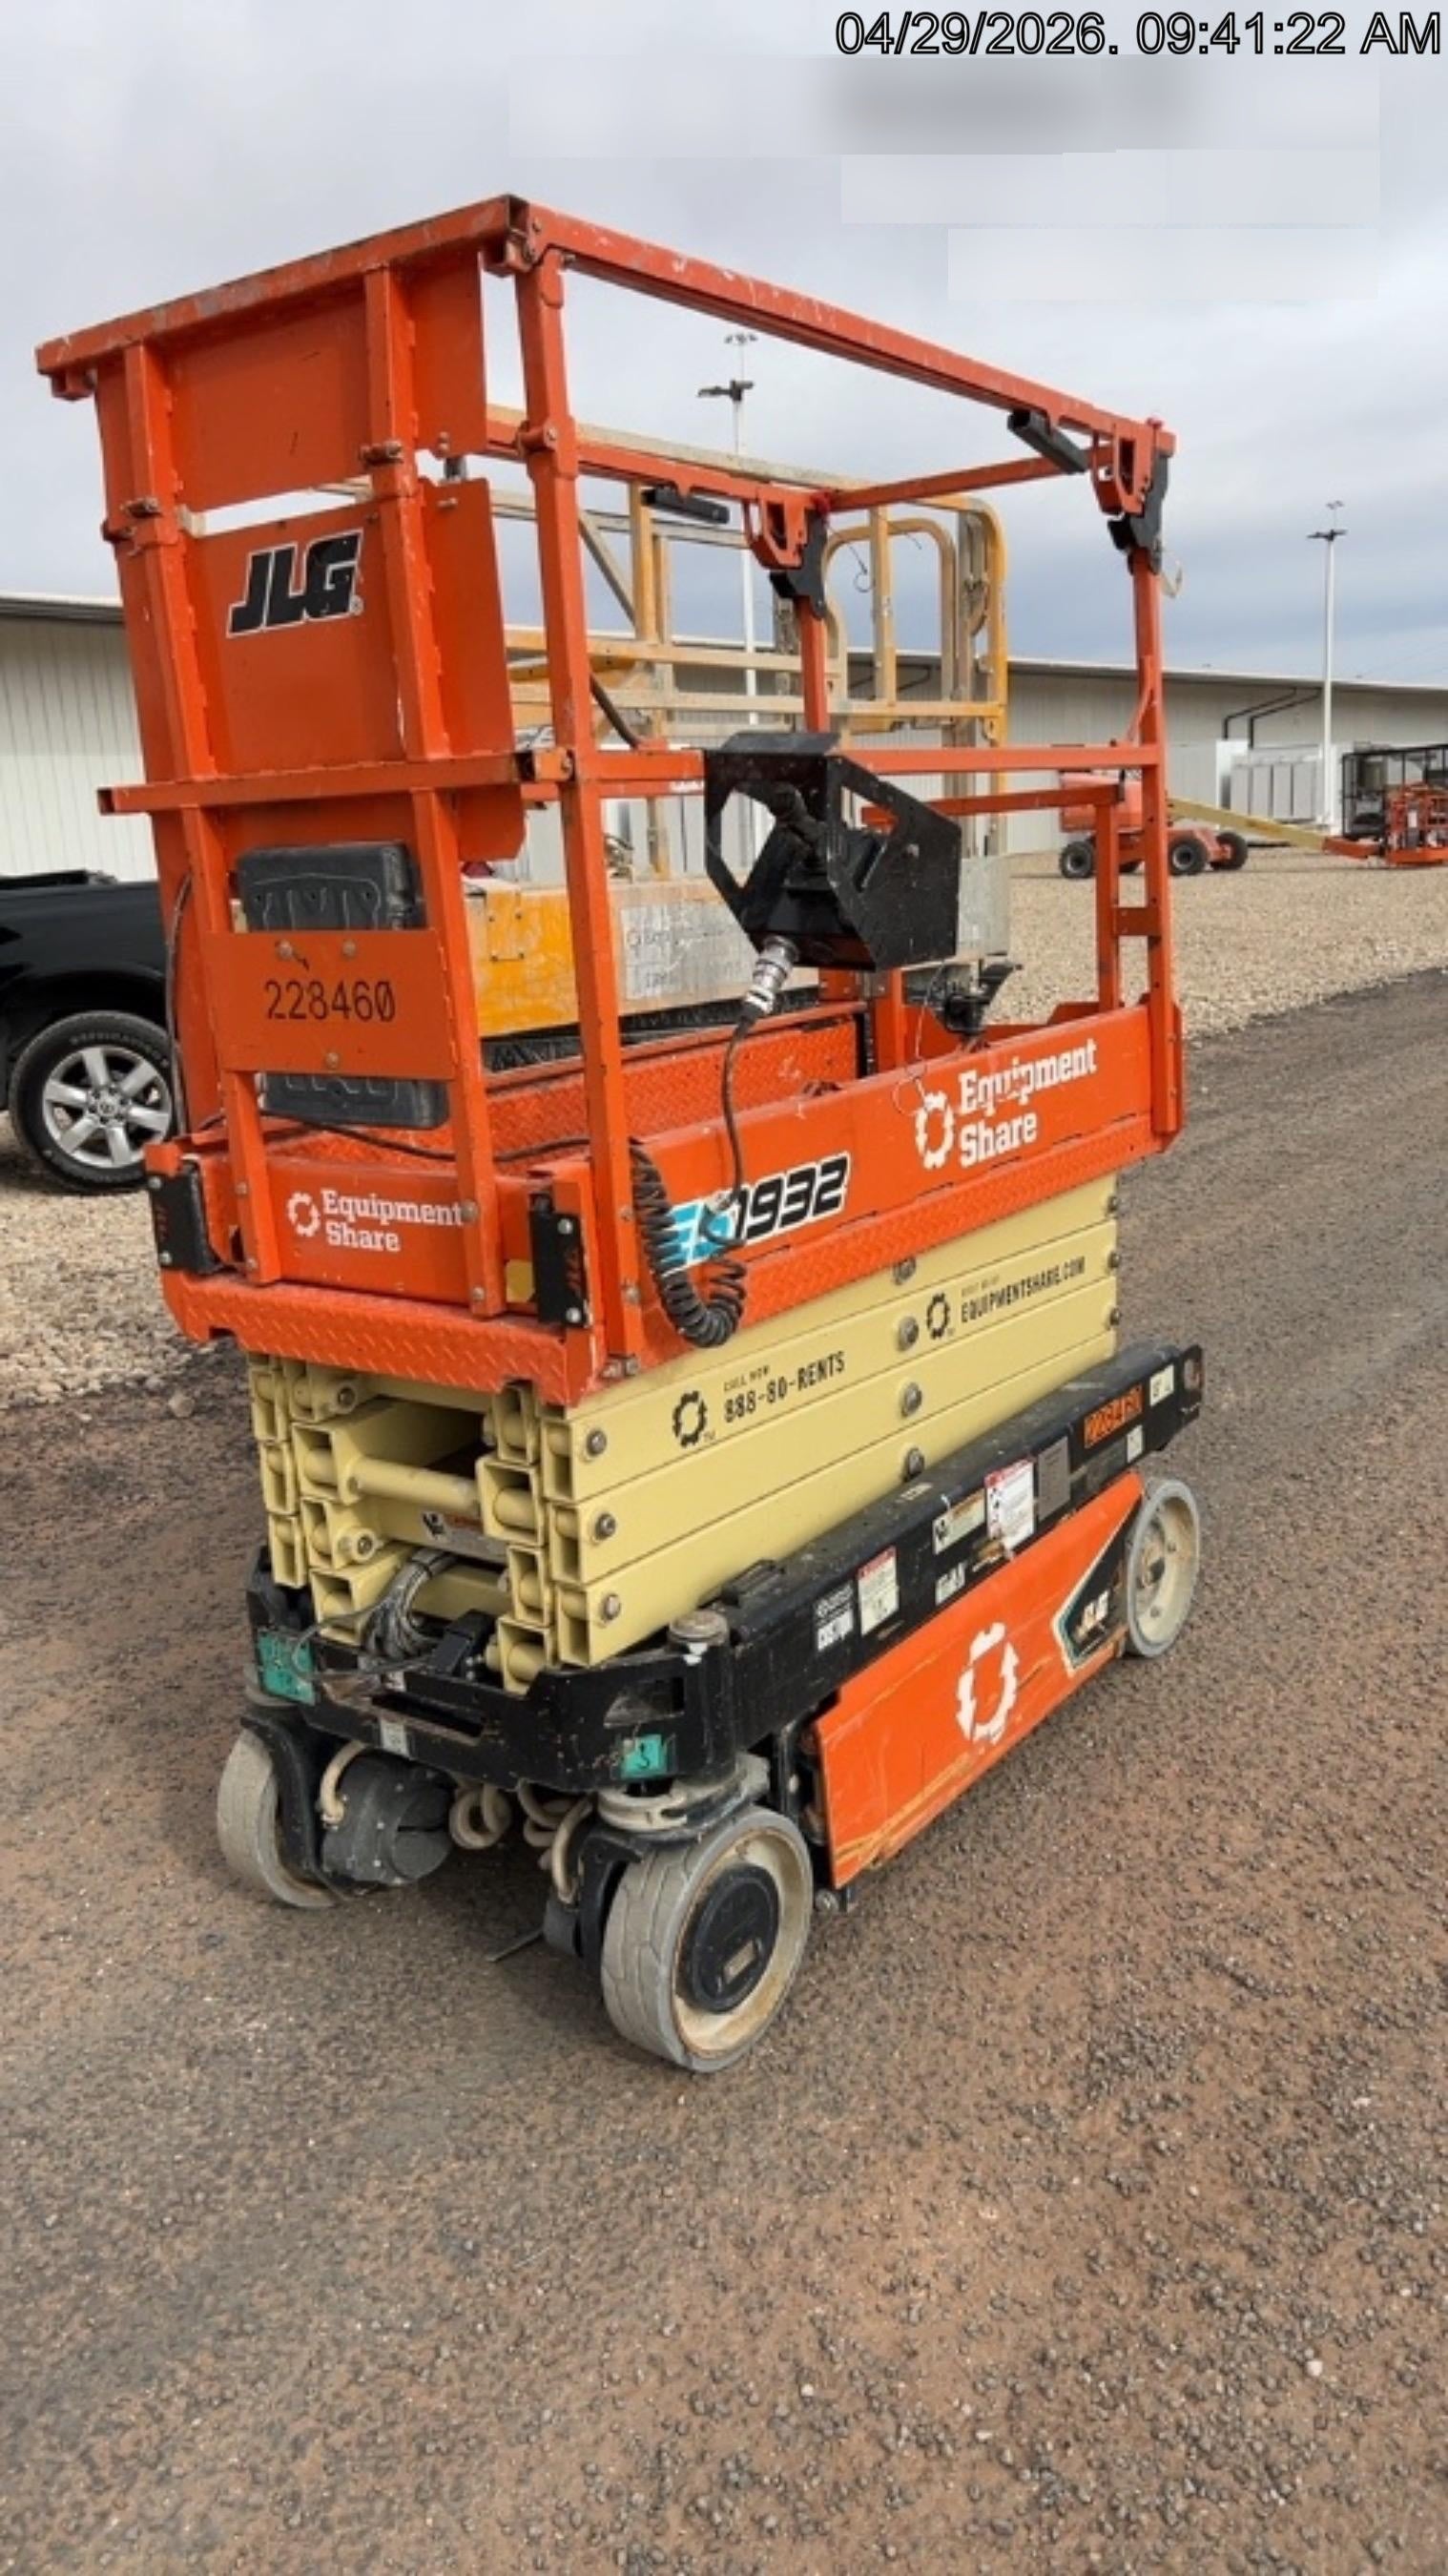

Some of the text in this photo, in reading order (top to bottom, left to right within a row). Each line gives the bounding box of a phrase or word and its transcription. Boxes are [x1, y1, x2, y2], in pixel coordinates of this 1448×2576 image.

[226, 527, 364, 638] JLG
[265, 980, 397, 1023] 228460
[959, 1038, 1097, 1117] Equipment
[960, 1112, 1038, 1168] Share
[320, 1188, 464, 1227] Equipment
[325, 1220, 402, 1253] Share
[725, 1350, 846, 1423] 888-80-RENTS
